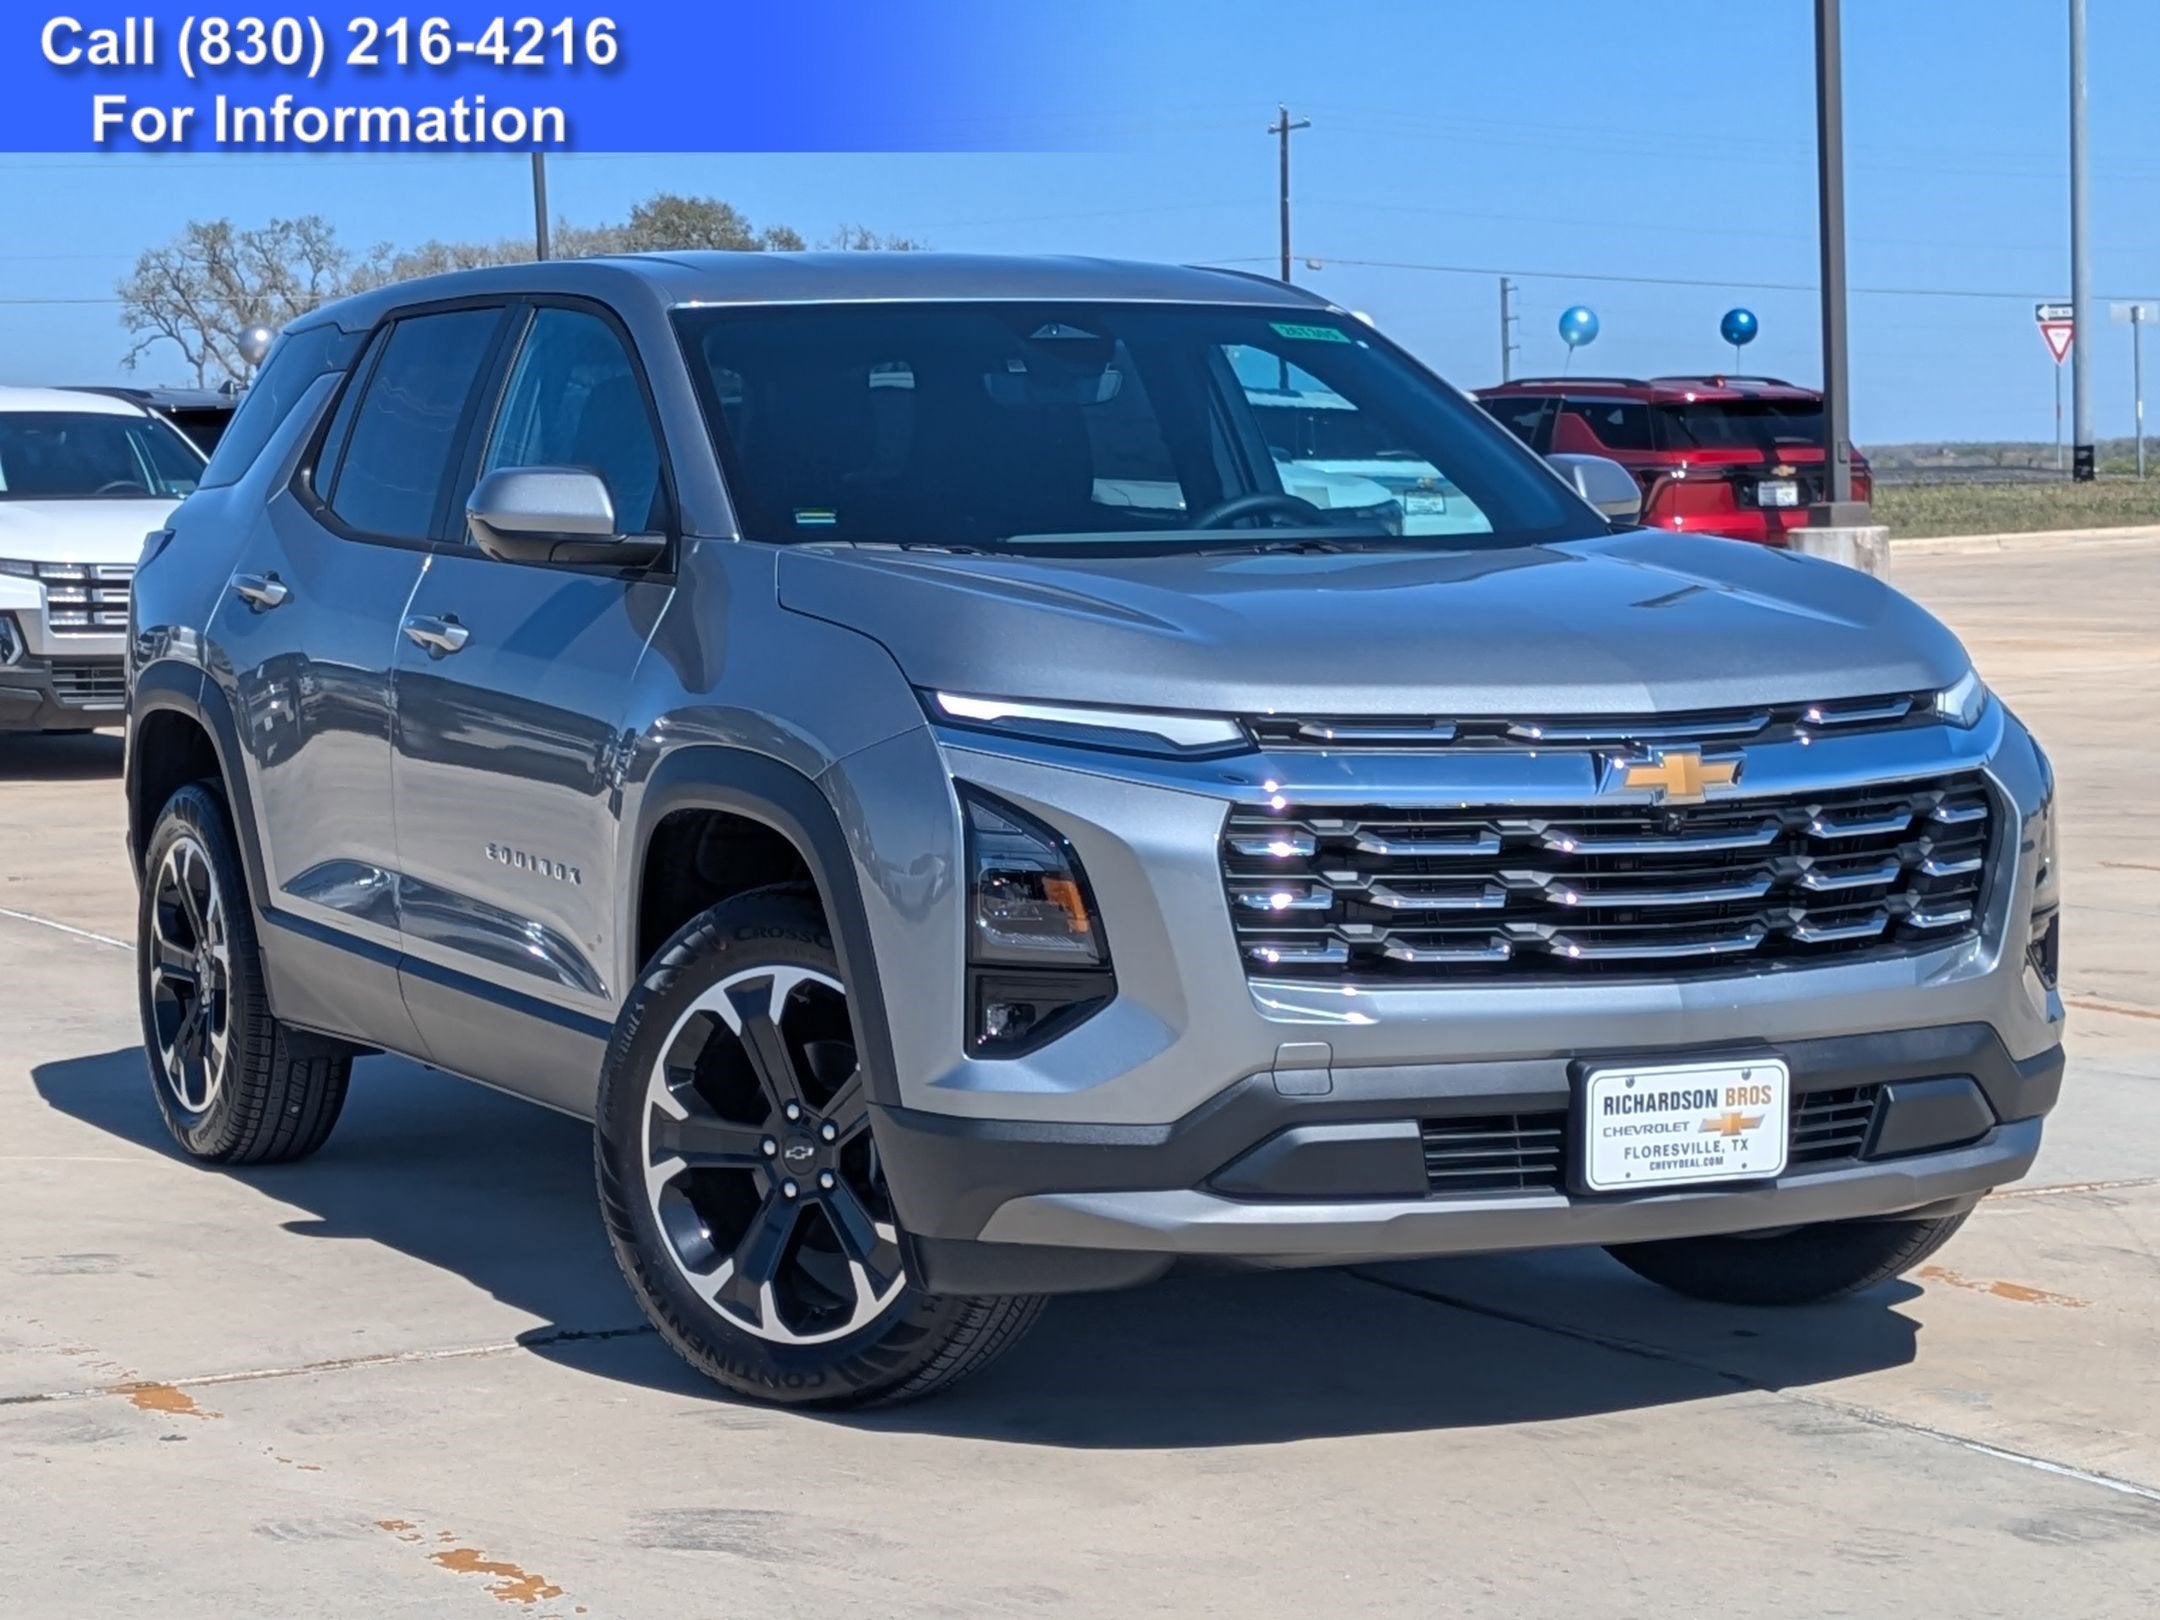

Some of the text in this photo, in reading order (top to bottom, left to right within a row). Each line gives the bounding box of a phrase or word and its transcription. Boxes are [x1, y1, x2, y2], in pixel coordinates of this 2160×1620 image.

[485, 842, 582, 885] EQUINOX
[1603, 1085, 1772, 1116] RICHARDSON BROS
[1603, 1121, 1690, 1138] CHEVROLET
[1624, 1138, 1749, 1160] FLORESVILLE, TX
[1649, 1156, 1724, 1171] CHEVYDEAL.COM
